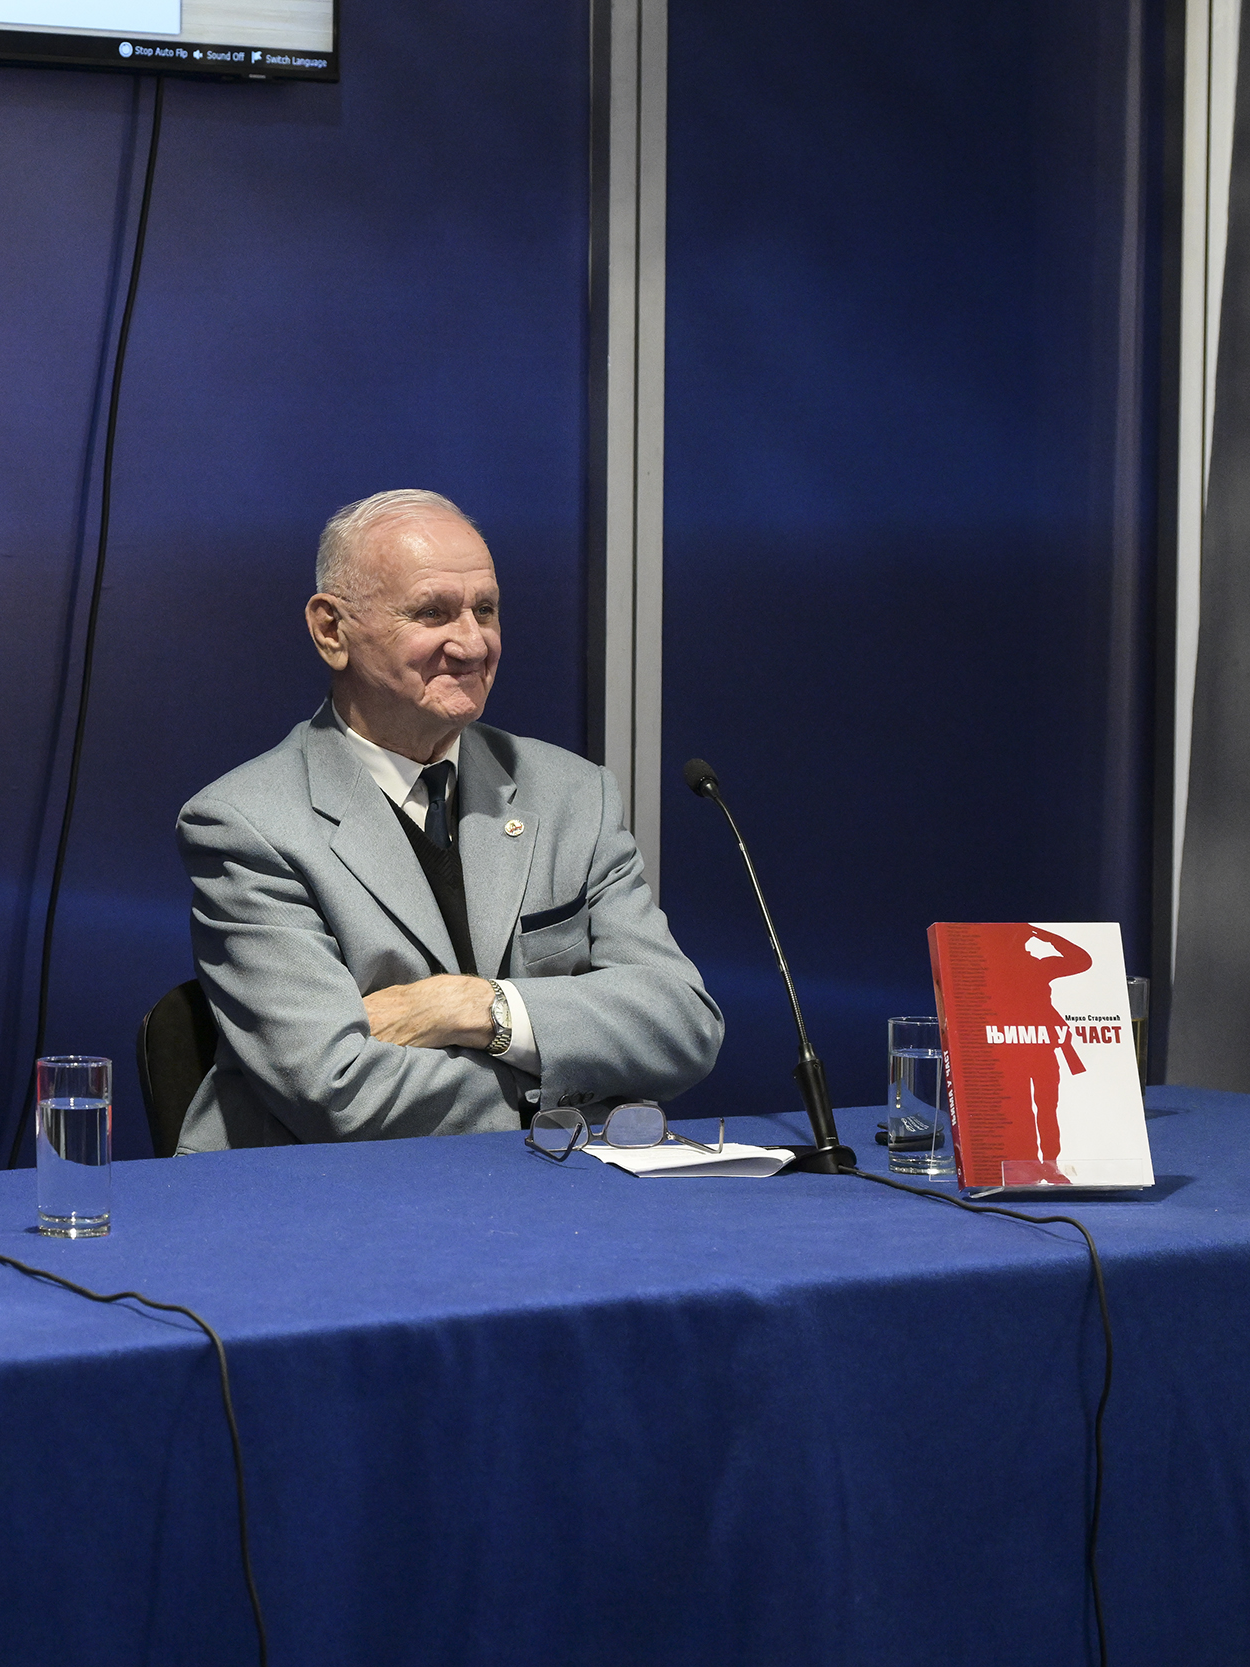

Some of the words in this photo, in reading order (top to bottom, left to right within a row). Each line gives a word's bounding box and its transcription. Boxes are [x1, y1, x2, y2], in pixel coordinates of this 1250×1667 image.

[134, 45, 154, 57] Stop
[155, 47, 175, 57] Auto
[175, 48, 188, 59] Flip
[207, 50, 231, 61] Sound
[232, 51, 245, 62] Off
[266, 54, 291, 65] Switch
[291, 56, 328, 69] Language
[986, 1025, 1051, 1044] ЊИМА
[1054, 1025, 1068, 1044] У
[1075, 1026, 1122, 1044] ЧАСТ
